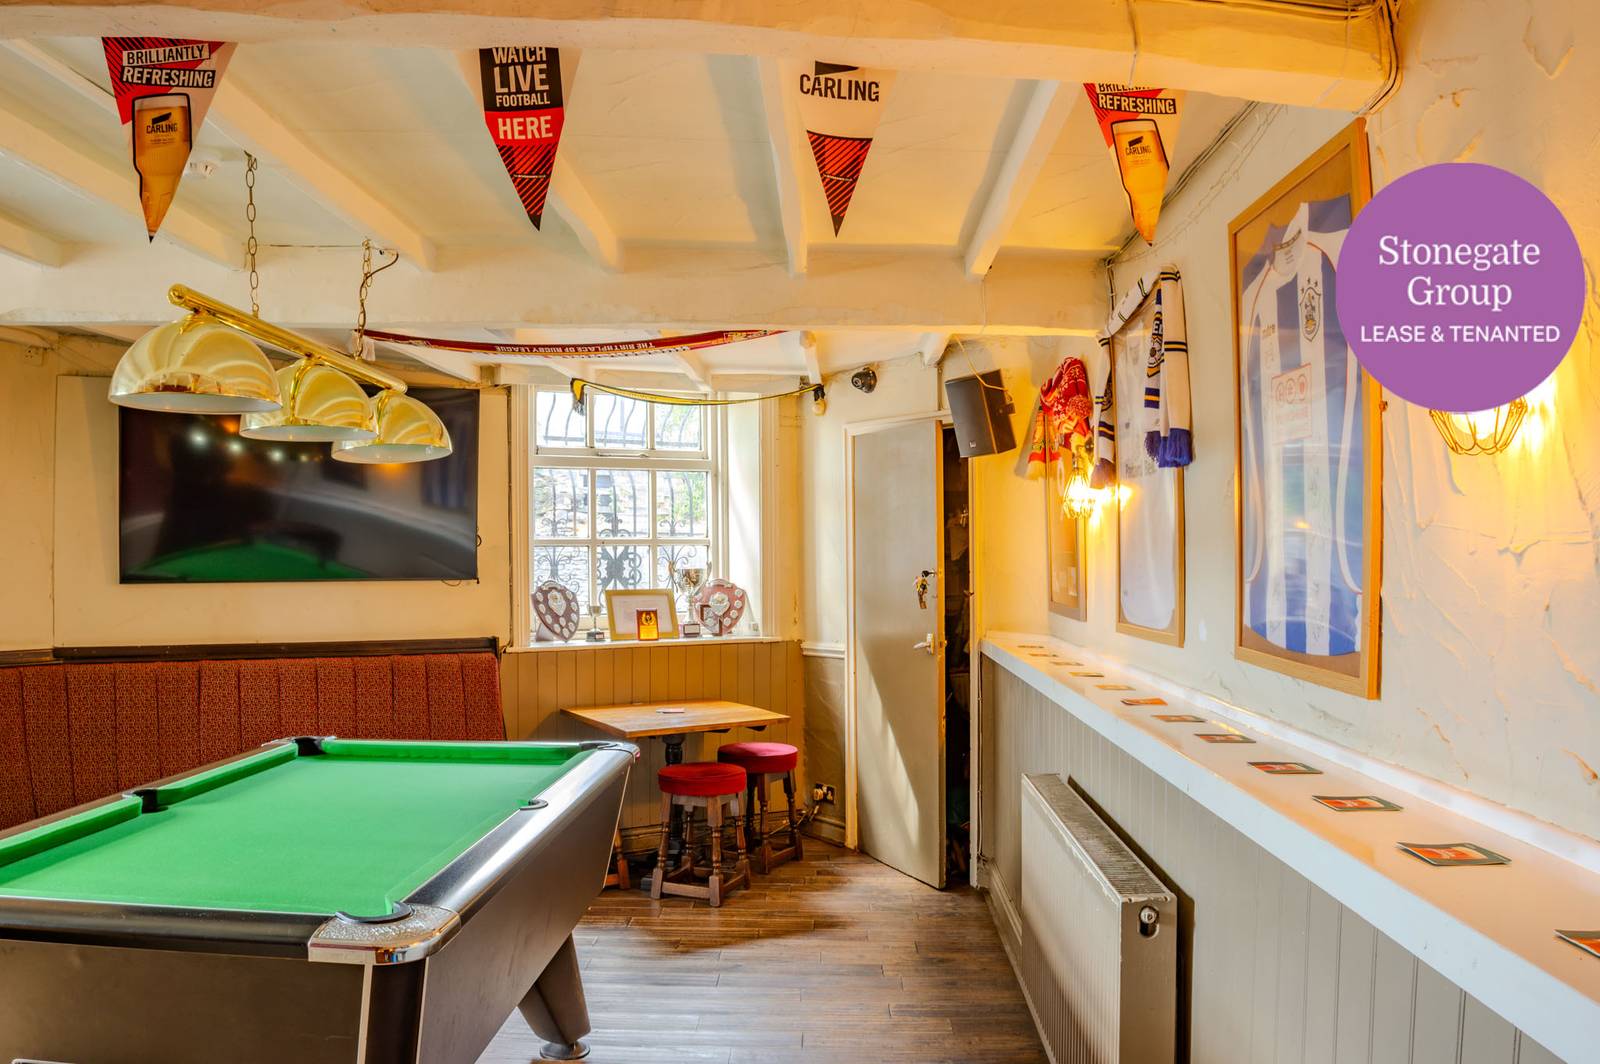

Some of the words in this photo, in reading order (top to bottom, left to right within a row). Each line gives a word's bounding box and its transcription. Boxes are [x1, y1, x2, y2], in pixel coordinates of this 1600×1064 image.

[127, 44, 205, 65] BRILLIANTLY
[492, 47, 547, 63] WATCH
[122, 67, 214, 87] REFRESHING
[493, 63, 549, 93] LIVE
[800, 74, 880, 102] CARLING
[495, 93, 550, 107] FOOTBALL
[1098, 94, 1175, 114] REFRESHING
[146, 123, 178, 134] CARLING
[497, 115, 553, 140] HERE
